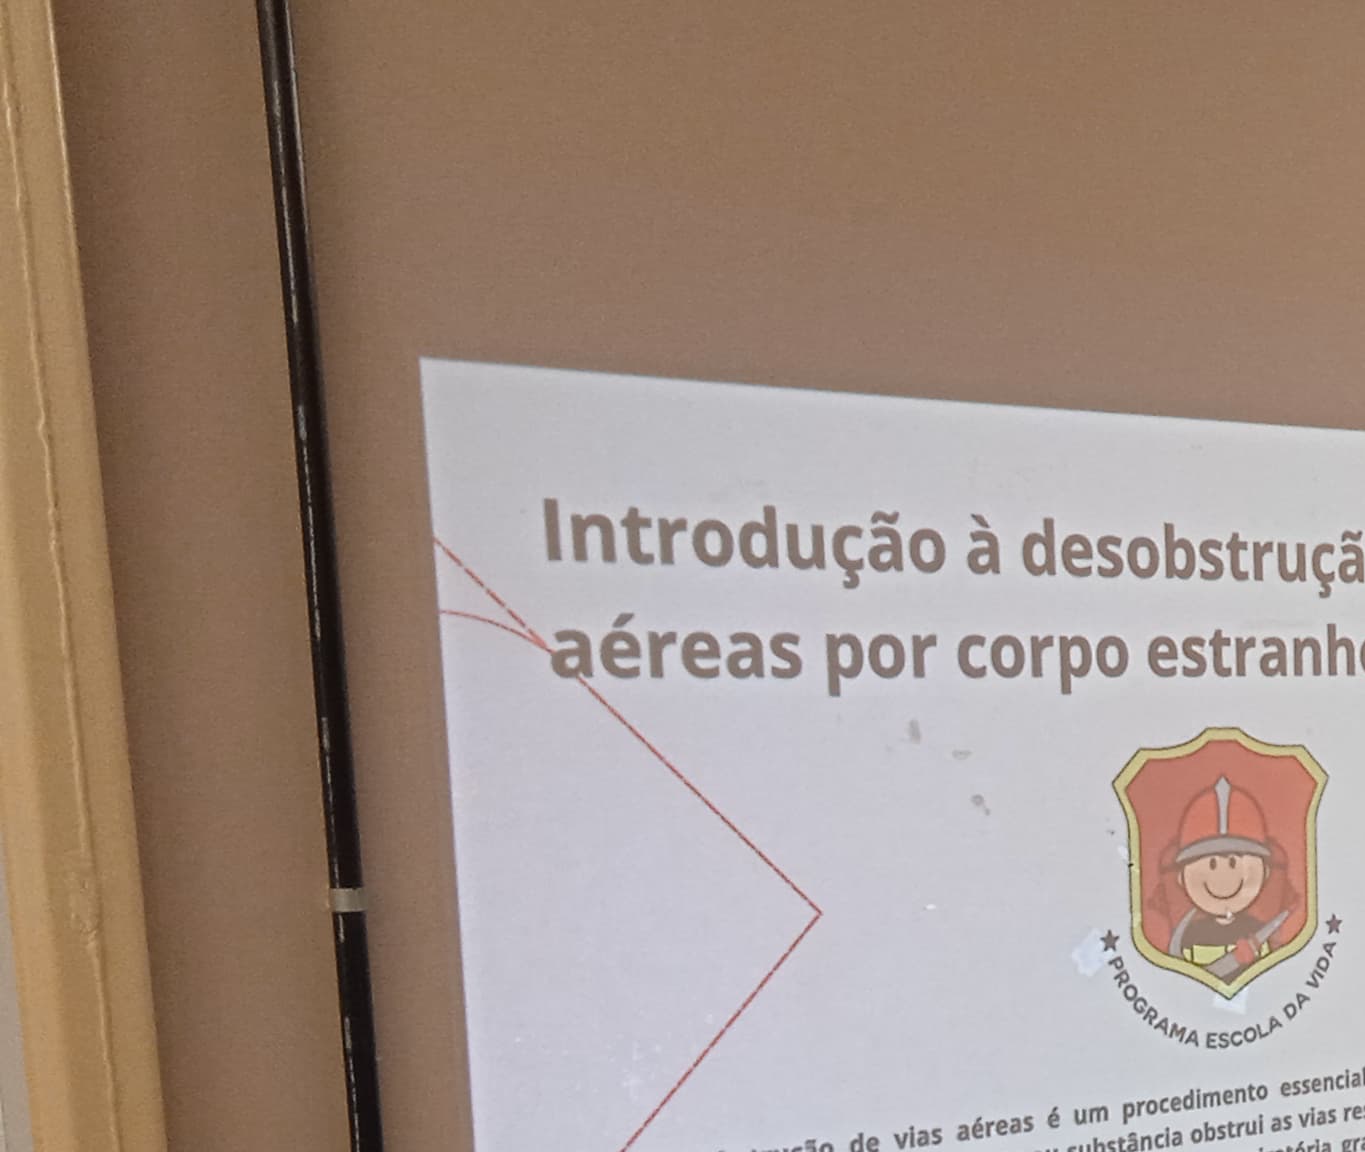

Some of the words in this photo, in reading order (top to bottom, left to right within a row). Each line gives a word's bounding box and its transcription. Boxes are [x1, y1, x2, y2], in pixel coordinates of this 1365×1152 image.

[543, 497, 945, 590] Introdução
[966, 513, 1001, 576] à
[551, 613, 803, 680] aéreas
[825, 632, 937, 698] por
[957, 632, 1129, 696] corpo
[1107, 955, 1200, 1048] PROGRAMA
[1205, 1015, 1283, 1050] ESCOLA
[1282, 991, 1312, 1022] DA
[1305, 940, 1338, 990] VIDA
[893, 1126, 943, 1150] vias
[956, 1114, 1035, 1142] aéreas
[1046, 1106, 1061, 1128] é
[1073, 1104, 1110, 1126] um
[1121, 1081, 1269, 1125] procedimento
[1190, 1114, 1264, 1144] obstrui
[1270, 1113, 1293, 1134] as
[1298, 1103, 1337, 1129] vias
